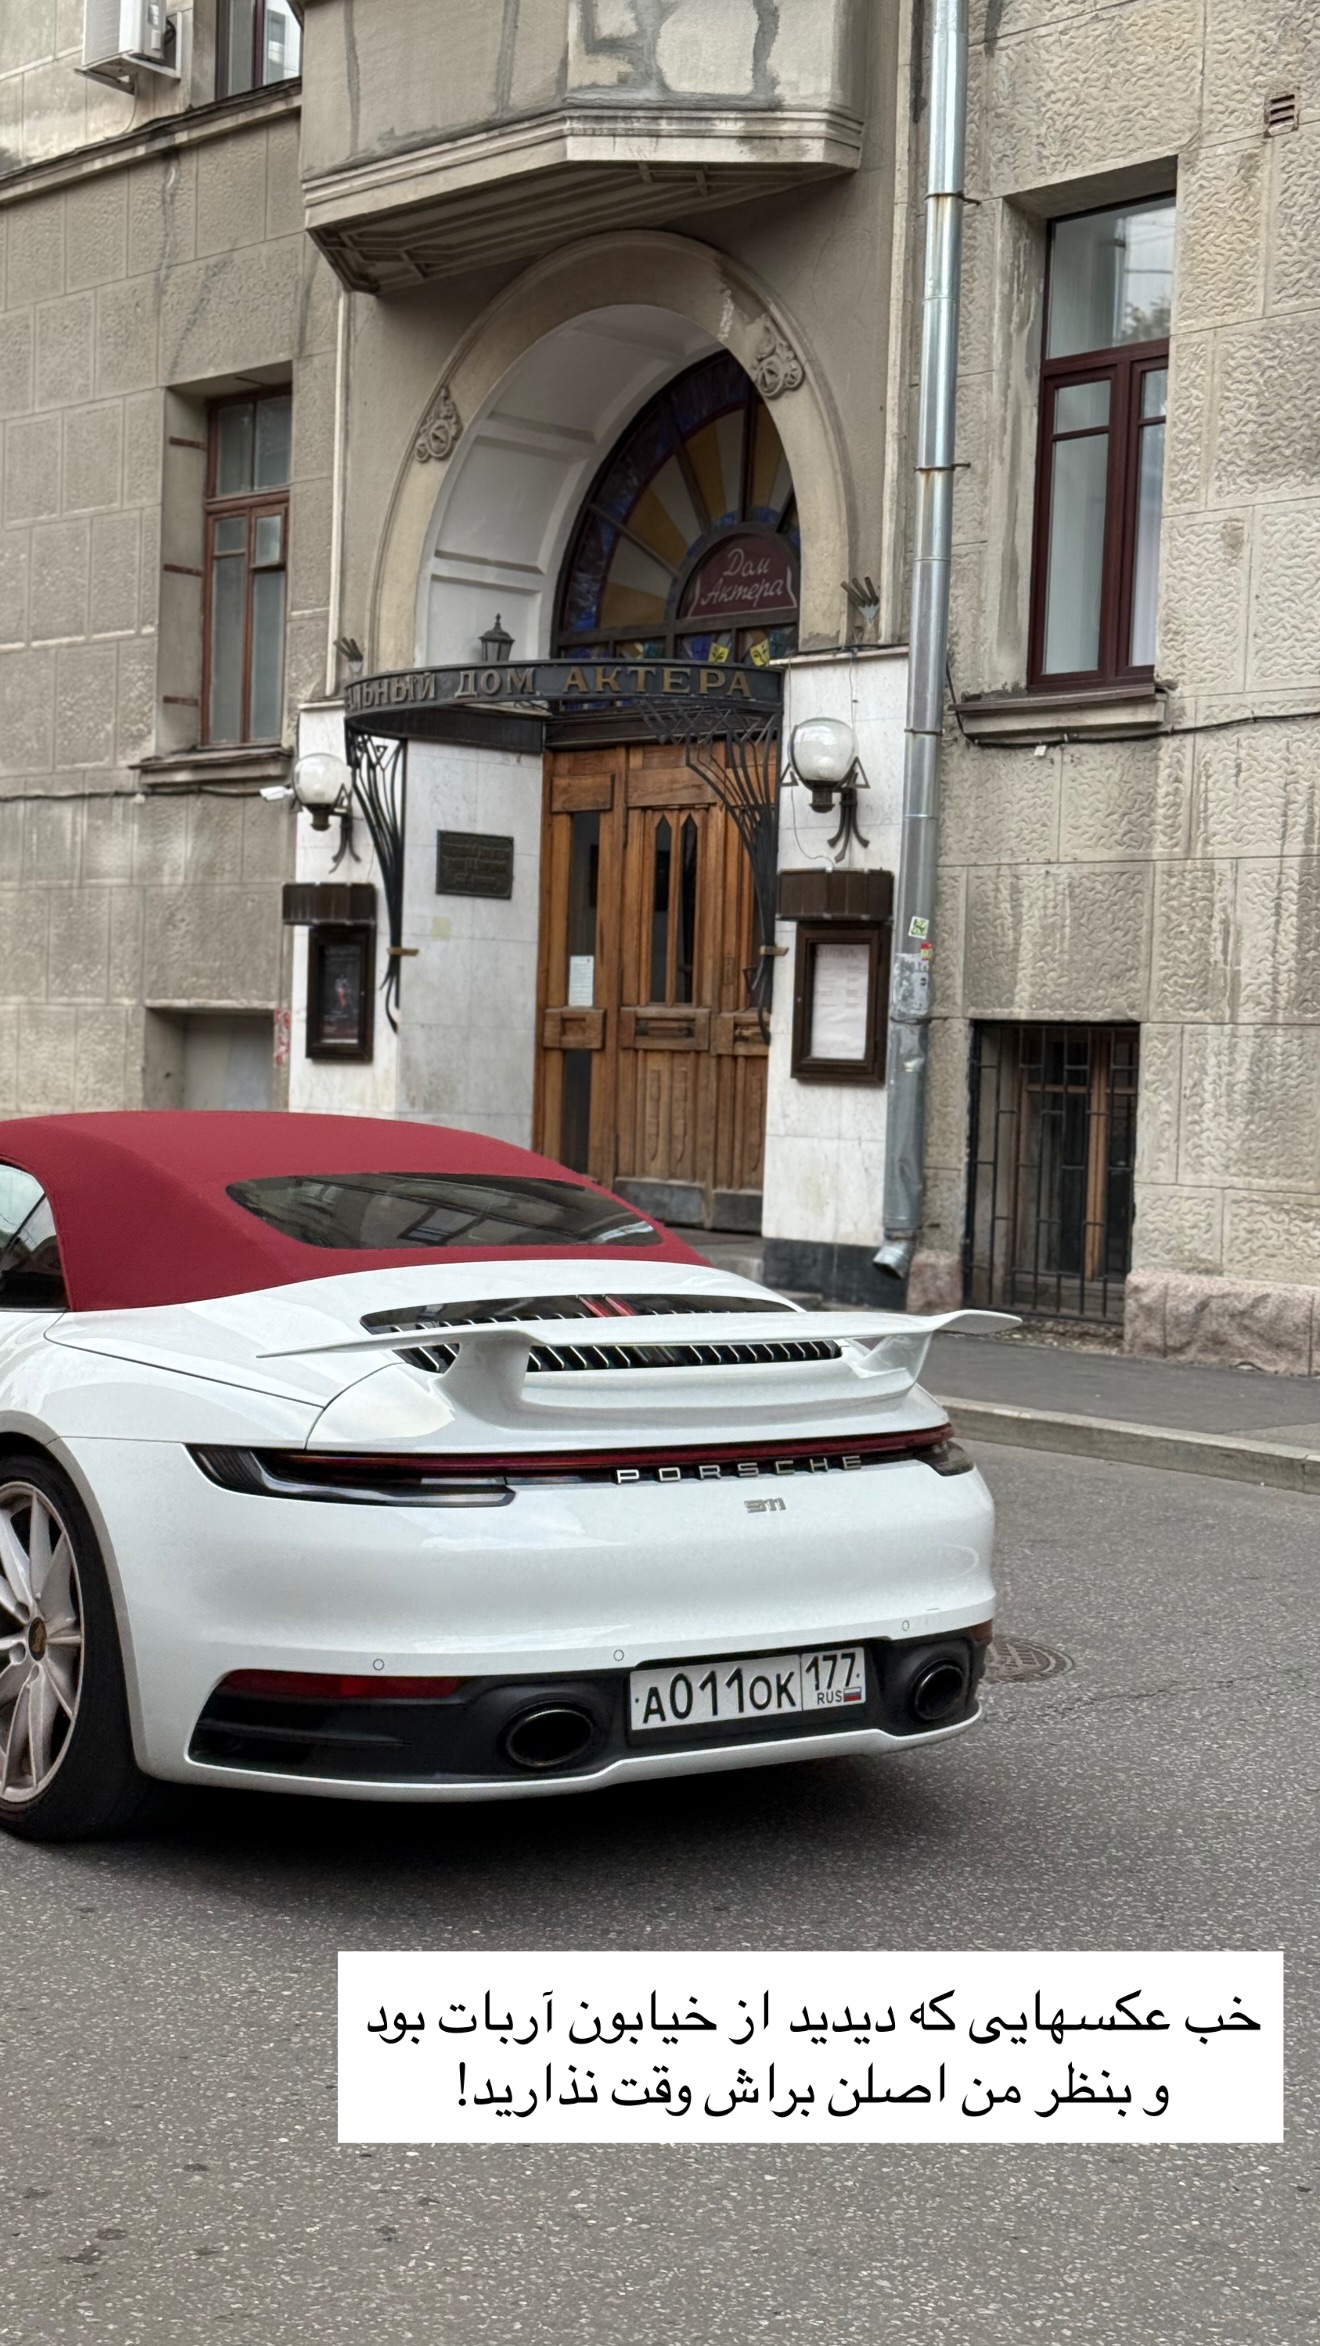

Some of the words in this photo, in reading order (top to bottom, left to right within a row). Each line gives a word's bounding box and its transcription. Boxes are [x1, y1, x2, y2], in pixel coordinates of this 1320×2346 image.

[723, 548, 770, 577] Дом
[701, 577, 784, 608] Актера
[454, 667, 537, 698] ДОМ
[563, 666, 753, 698] АКТЕРА
[616, 1455, 862, 1485] PORSCHE
[744, 1497, 787, 1514] 911
[805, 1652, 857, 1692] 177
[816, 1690, 843, 1706] RUS
